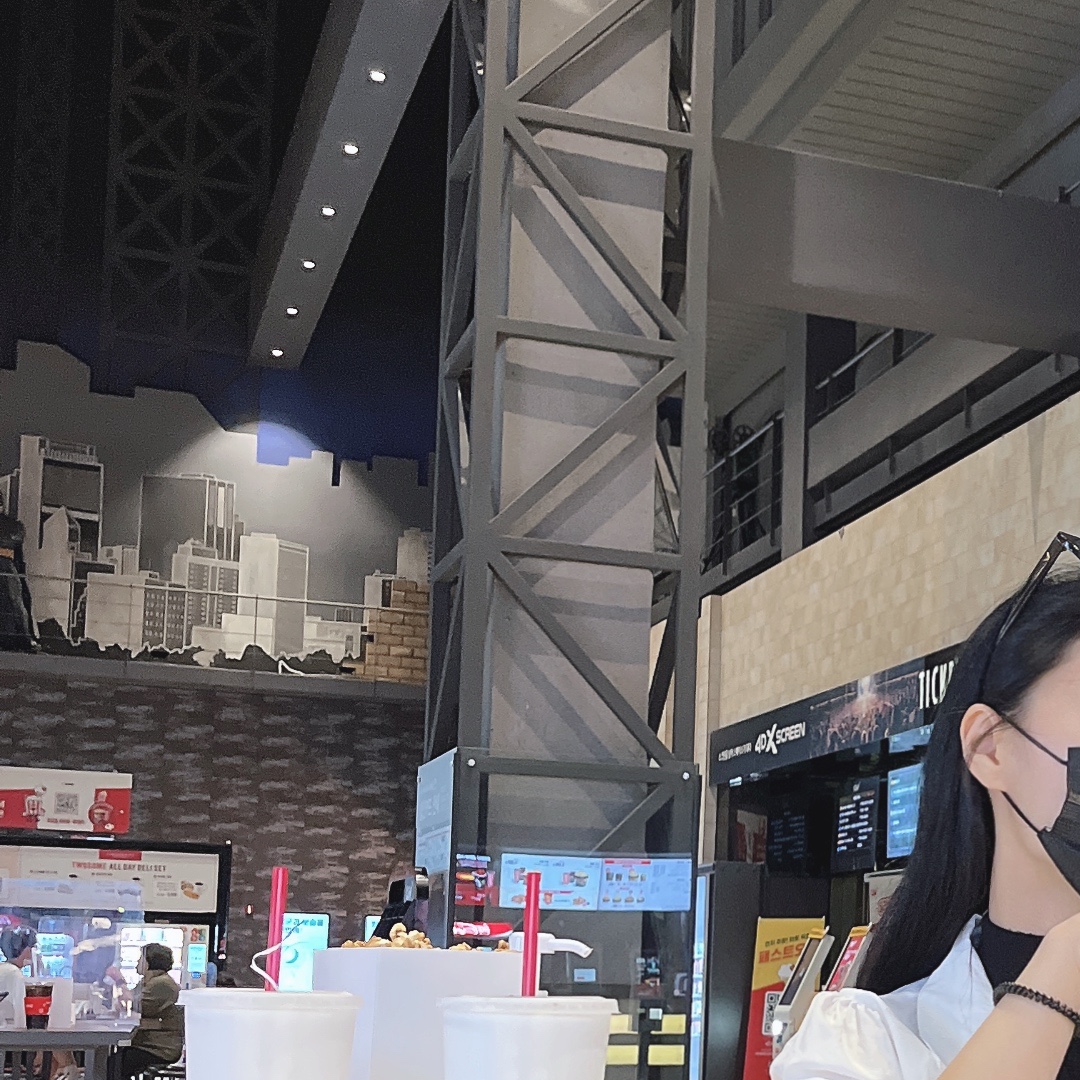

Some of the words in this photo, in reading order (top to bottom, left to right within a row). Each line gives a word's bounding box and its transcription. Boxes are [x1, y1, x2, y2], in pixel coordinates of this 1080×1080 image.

[919, 660, 955, 710] TICK
[754, 723, 778, 755] 4DX
[775, 722, 806, 745] SCREEN
